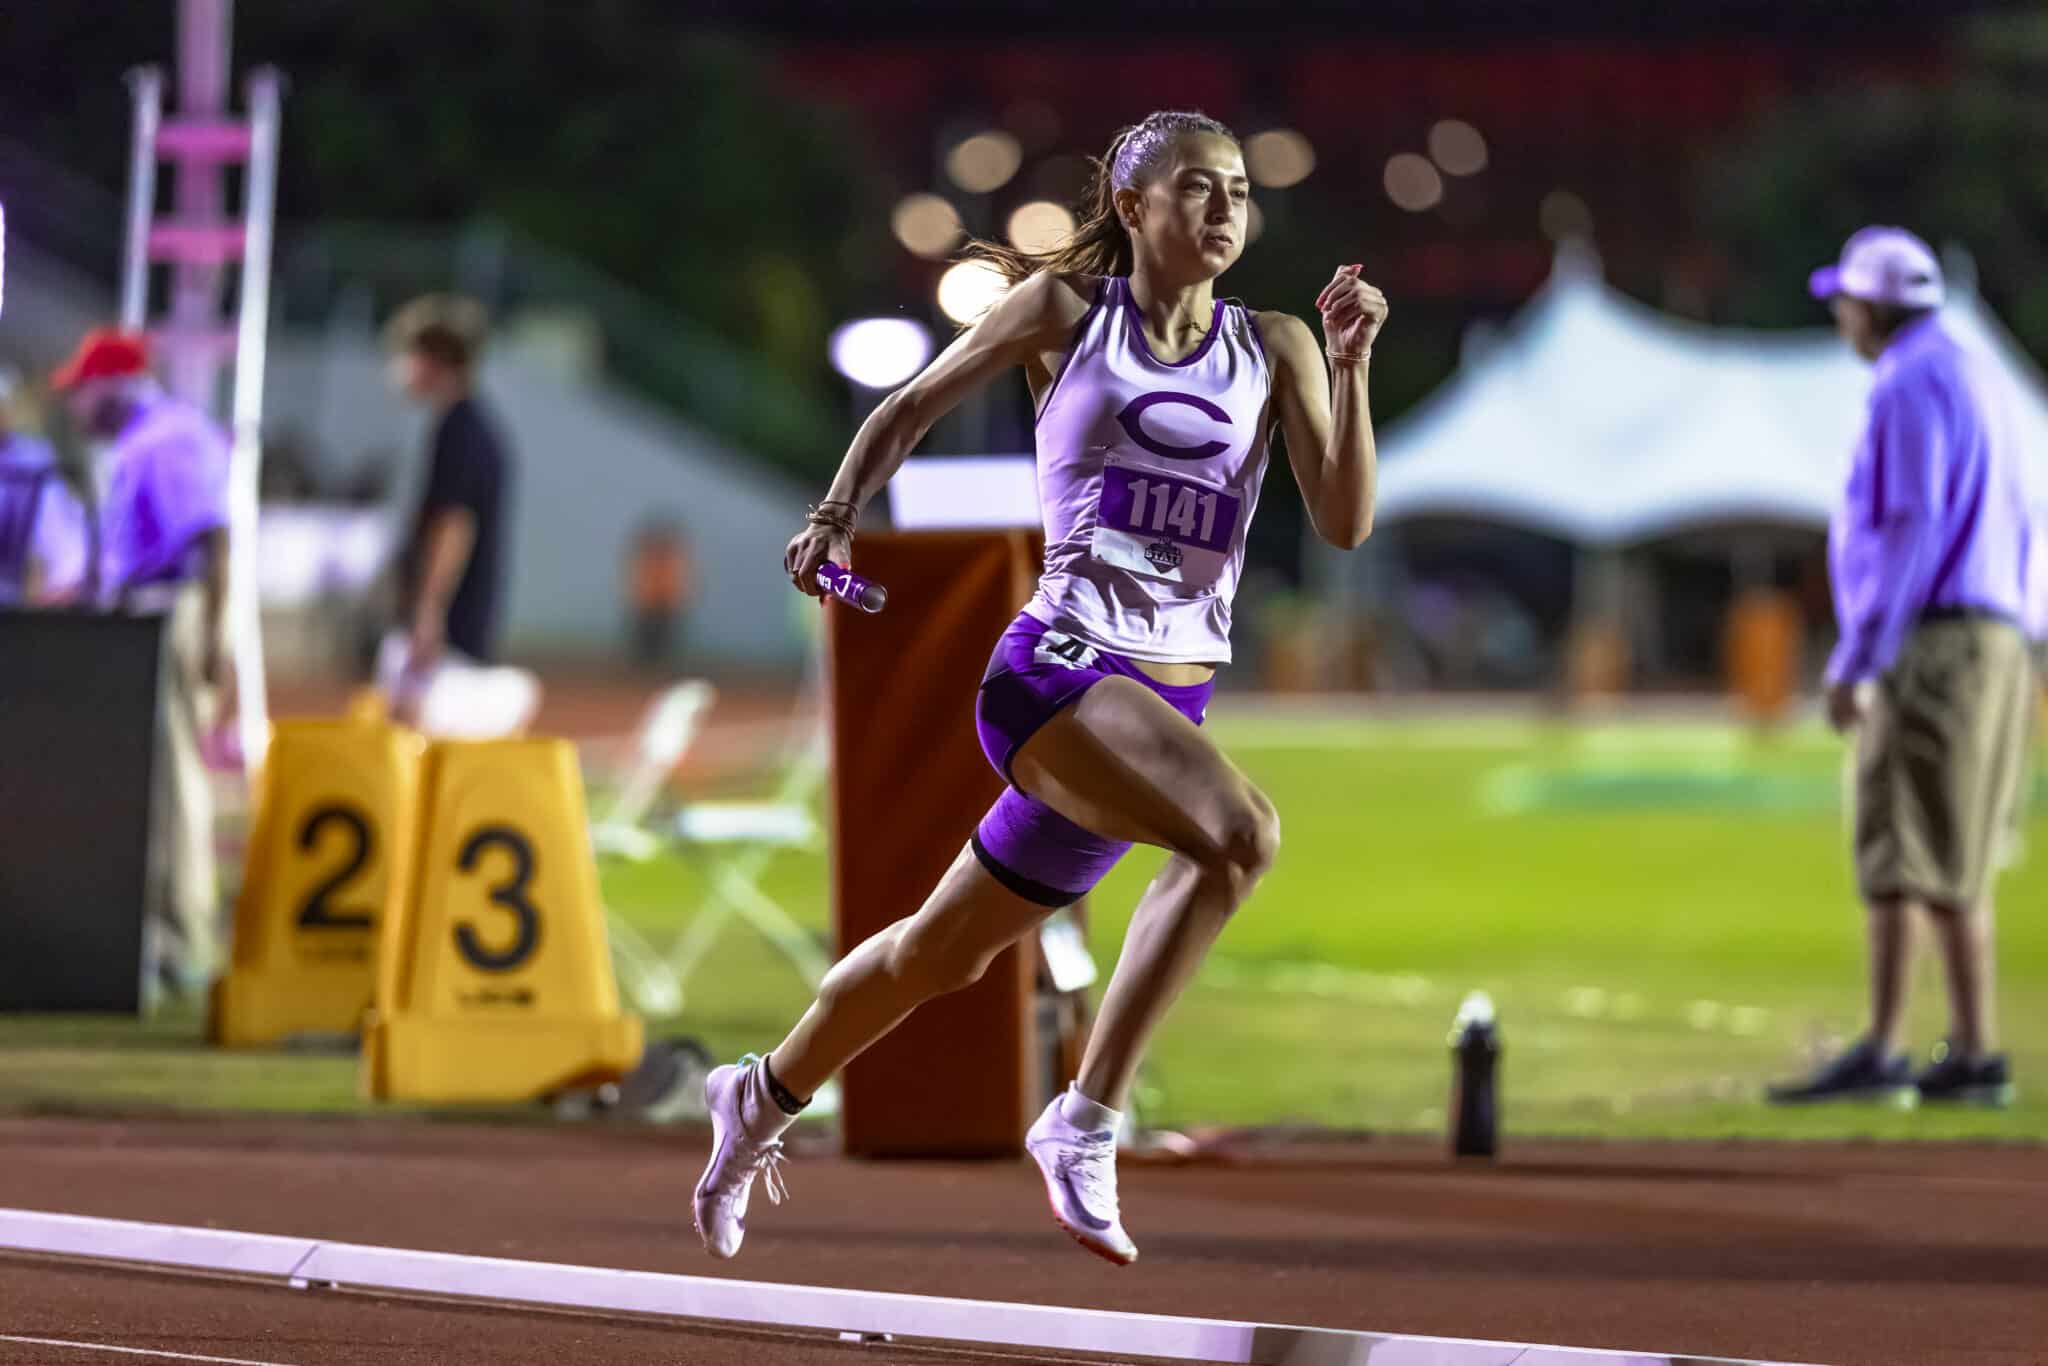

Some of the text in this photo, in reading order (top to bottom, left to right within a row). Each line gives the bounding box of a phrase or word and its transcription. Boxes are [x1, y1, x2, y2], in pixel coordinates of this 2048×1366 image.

[1116, 391, 1233, 460] C
[1128, 478, 1218, 542] 1141
[1145, 549, 1183, 564] STATE
[297, 803, 376, 931] 2
[455, 826, 543, 971] 3
